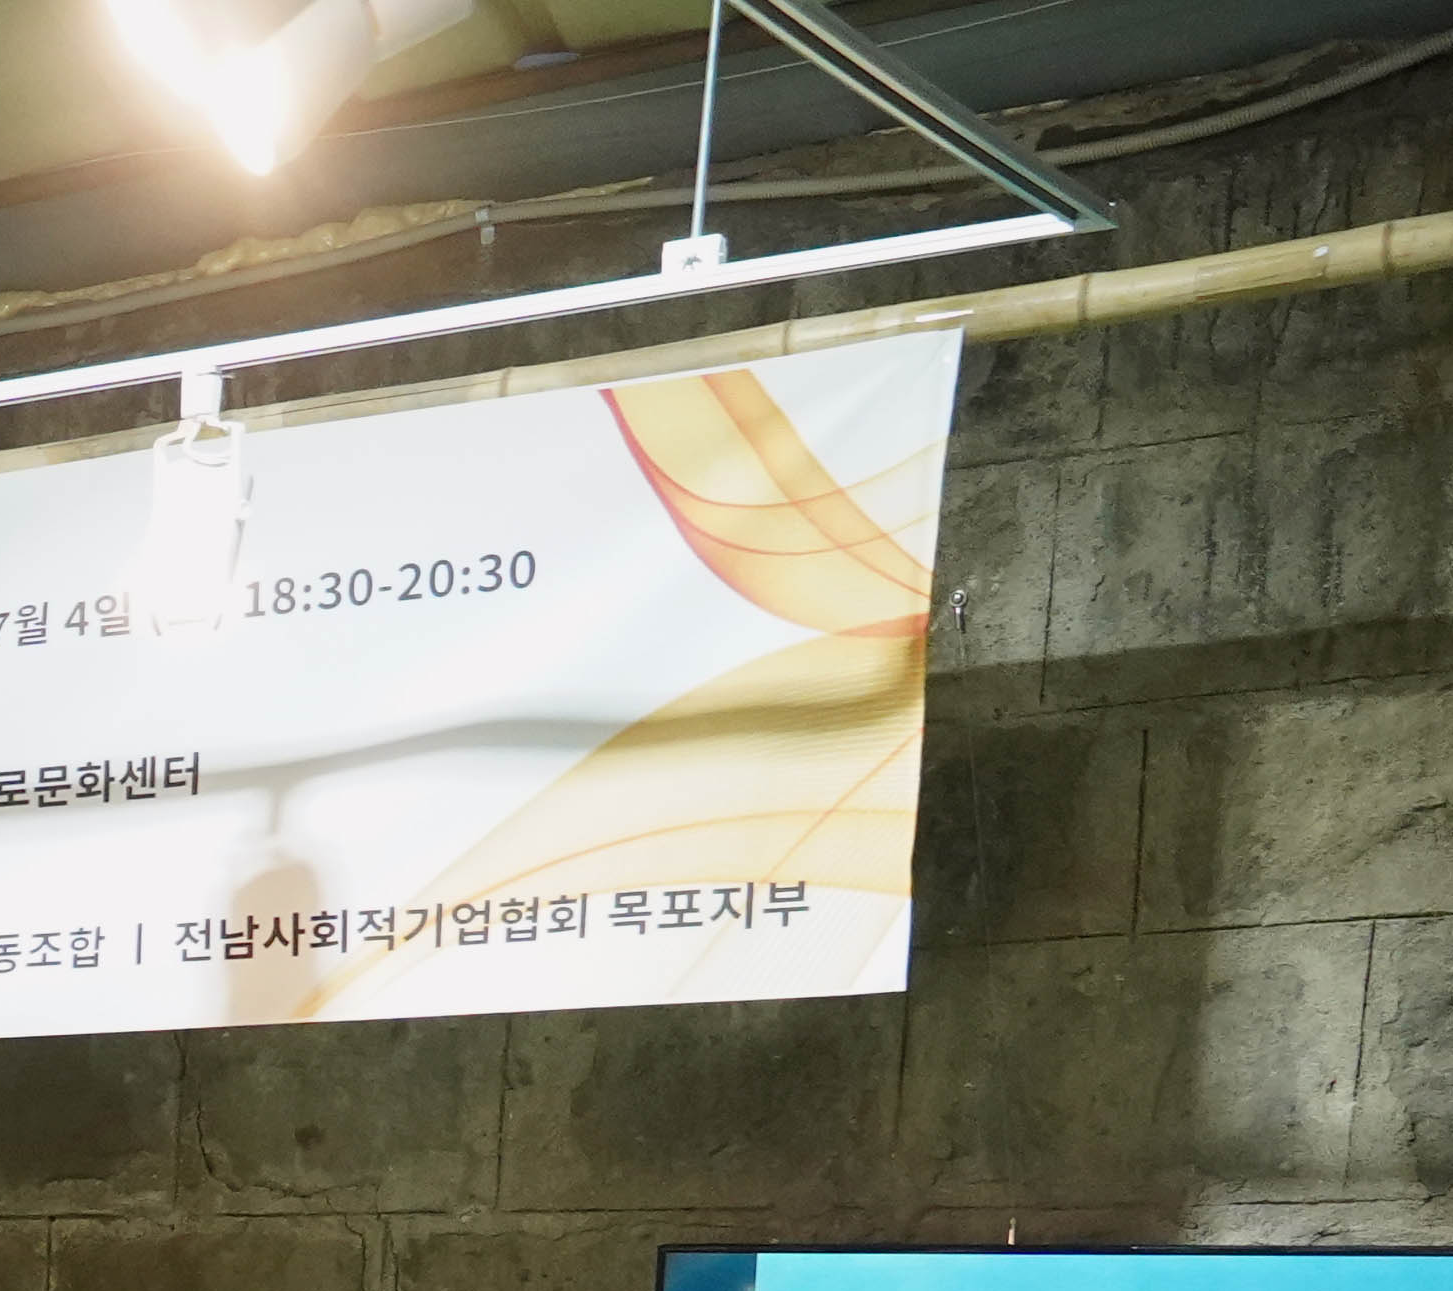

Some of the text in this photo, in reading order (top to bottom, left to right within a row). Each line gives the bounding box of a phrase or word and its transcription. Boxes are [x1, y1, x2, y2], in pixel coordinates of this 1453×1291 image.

[64, 590, 132, 638] 4일
[244, 549, 538, 620] 18:30-20:30
[173, 879, 812, 964] 전남사회적기업협회 목포지부
